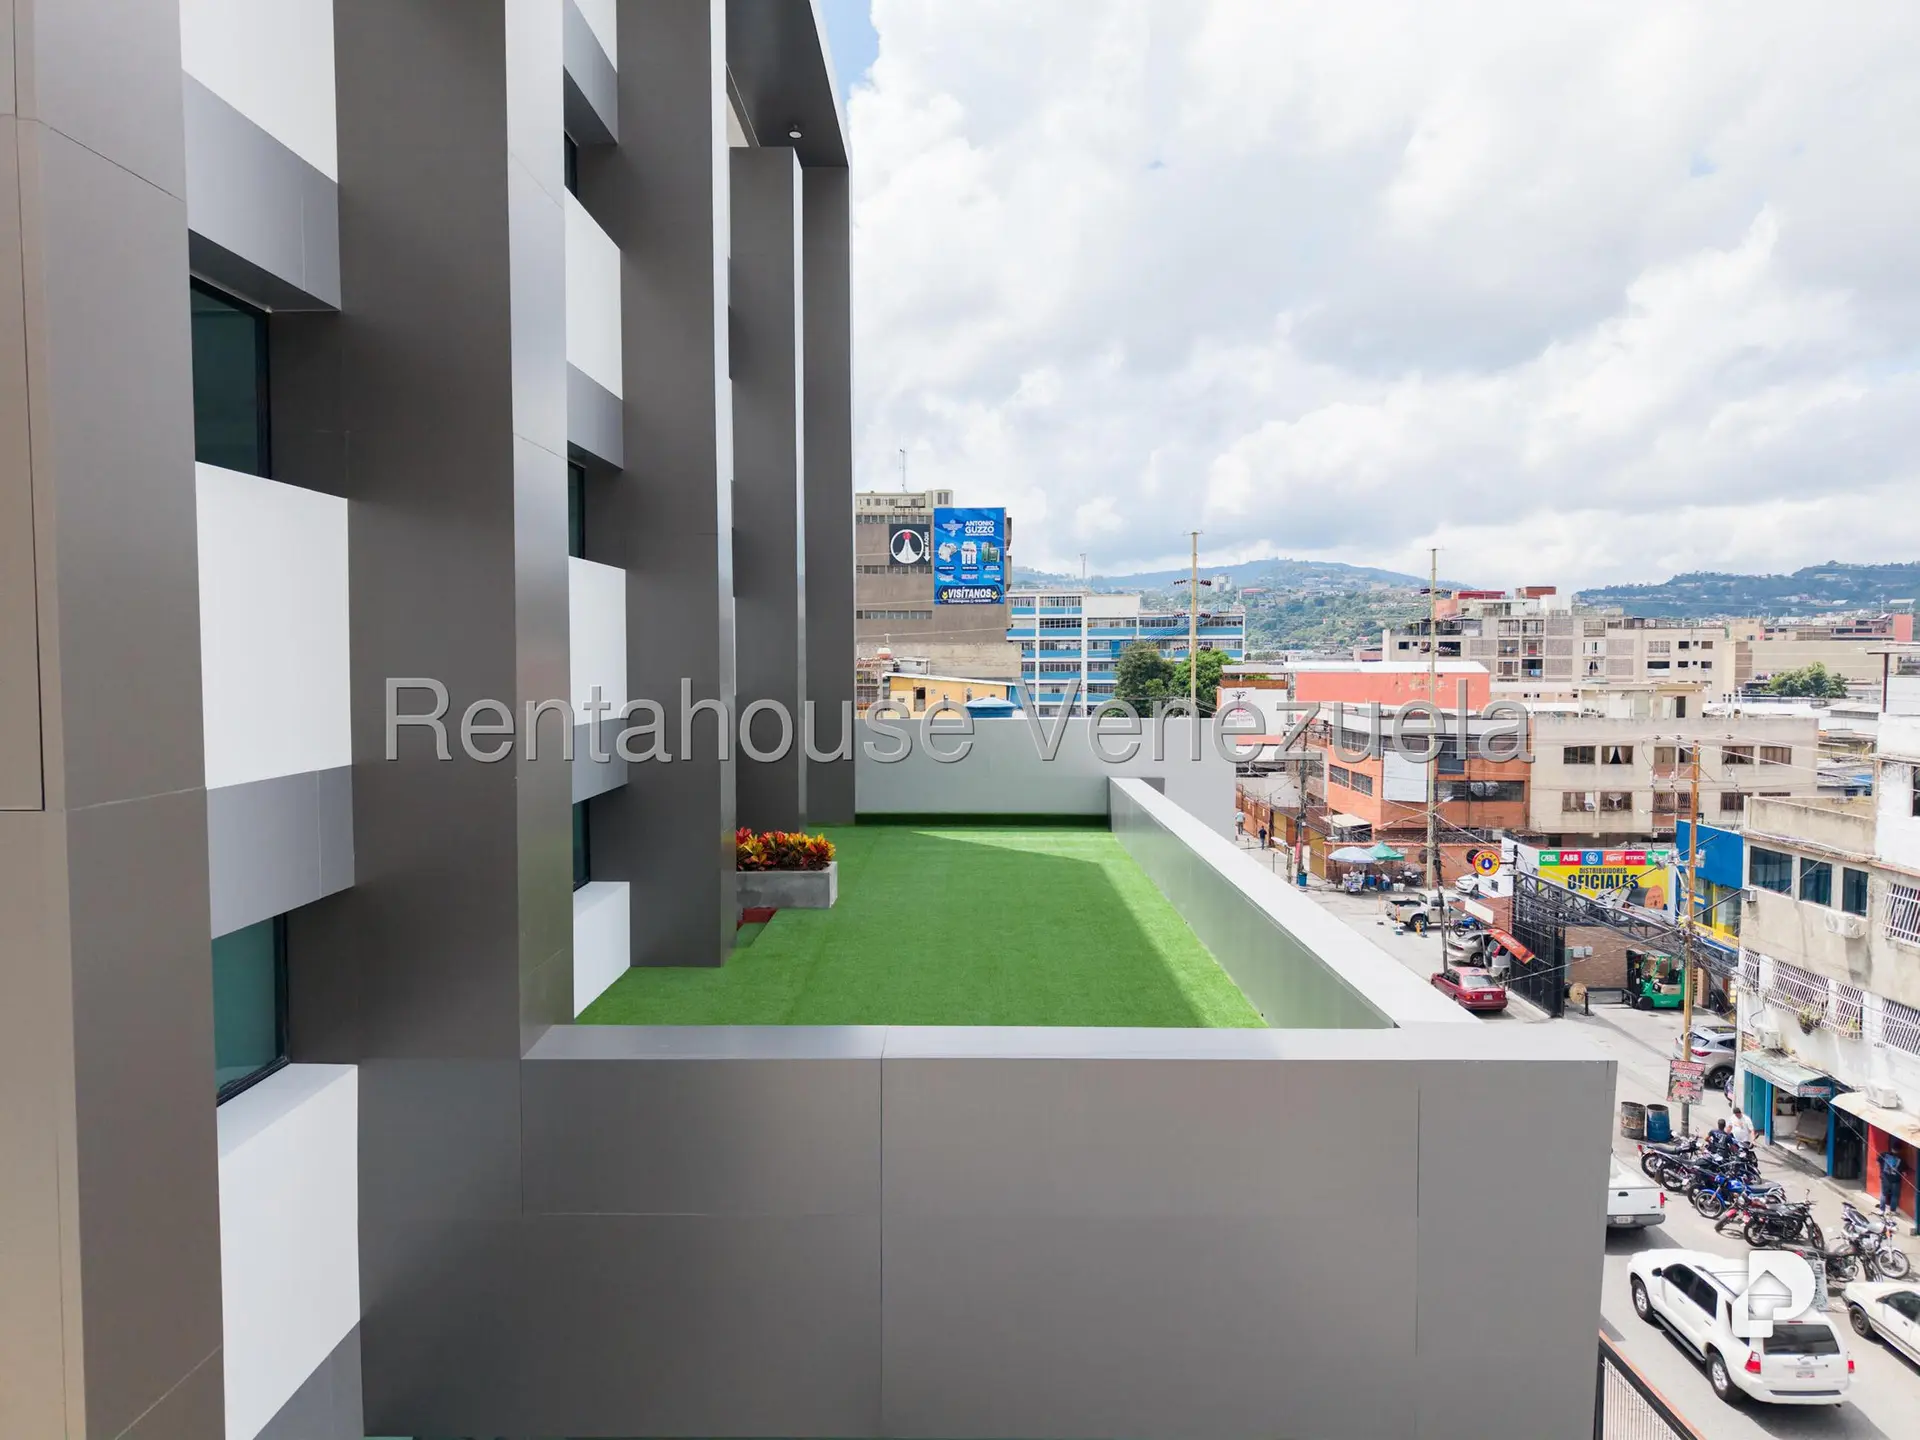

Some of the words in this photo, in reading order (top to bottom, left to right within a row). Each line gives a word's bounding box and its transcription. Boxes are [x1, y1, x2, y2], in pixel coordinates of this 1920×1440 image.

[965, 526, 994, 534] GUZZO
[948, 586, 992, 599] VISÍTANOS
[1562, 854, 1579, 862] ABB
[1567, 874, 1639, 890] OFICIALES
